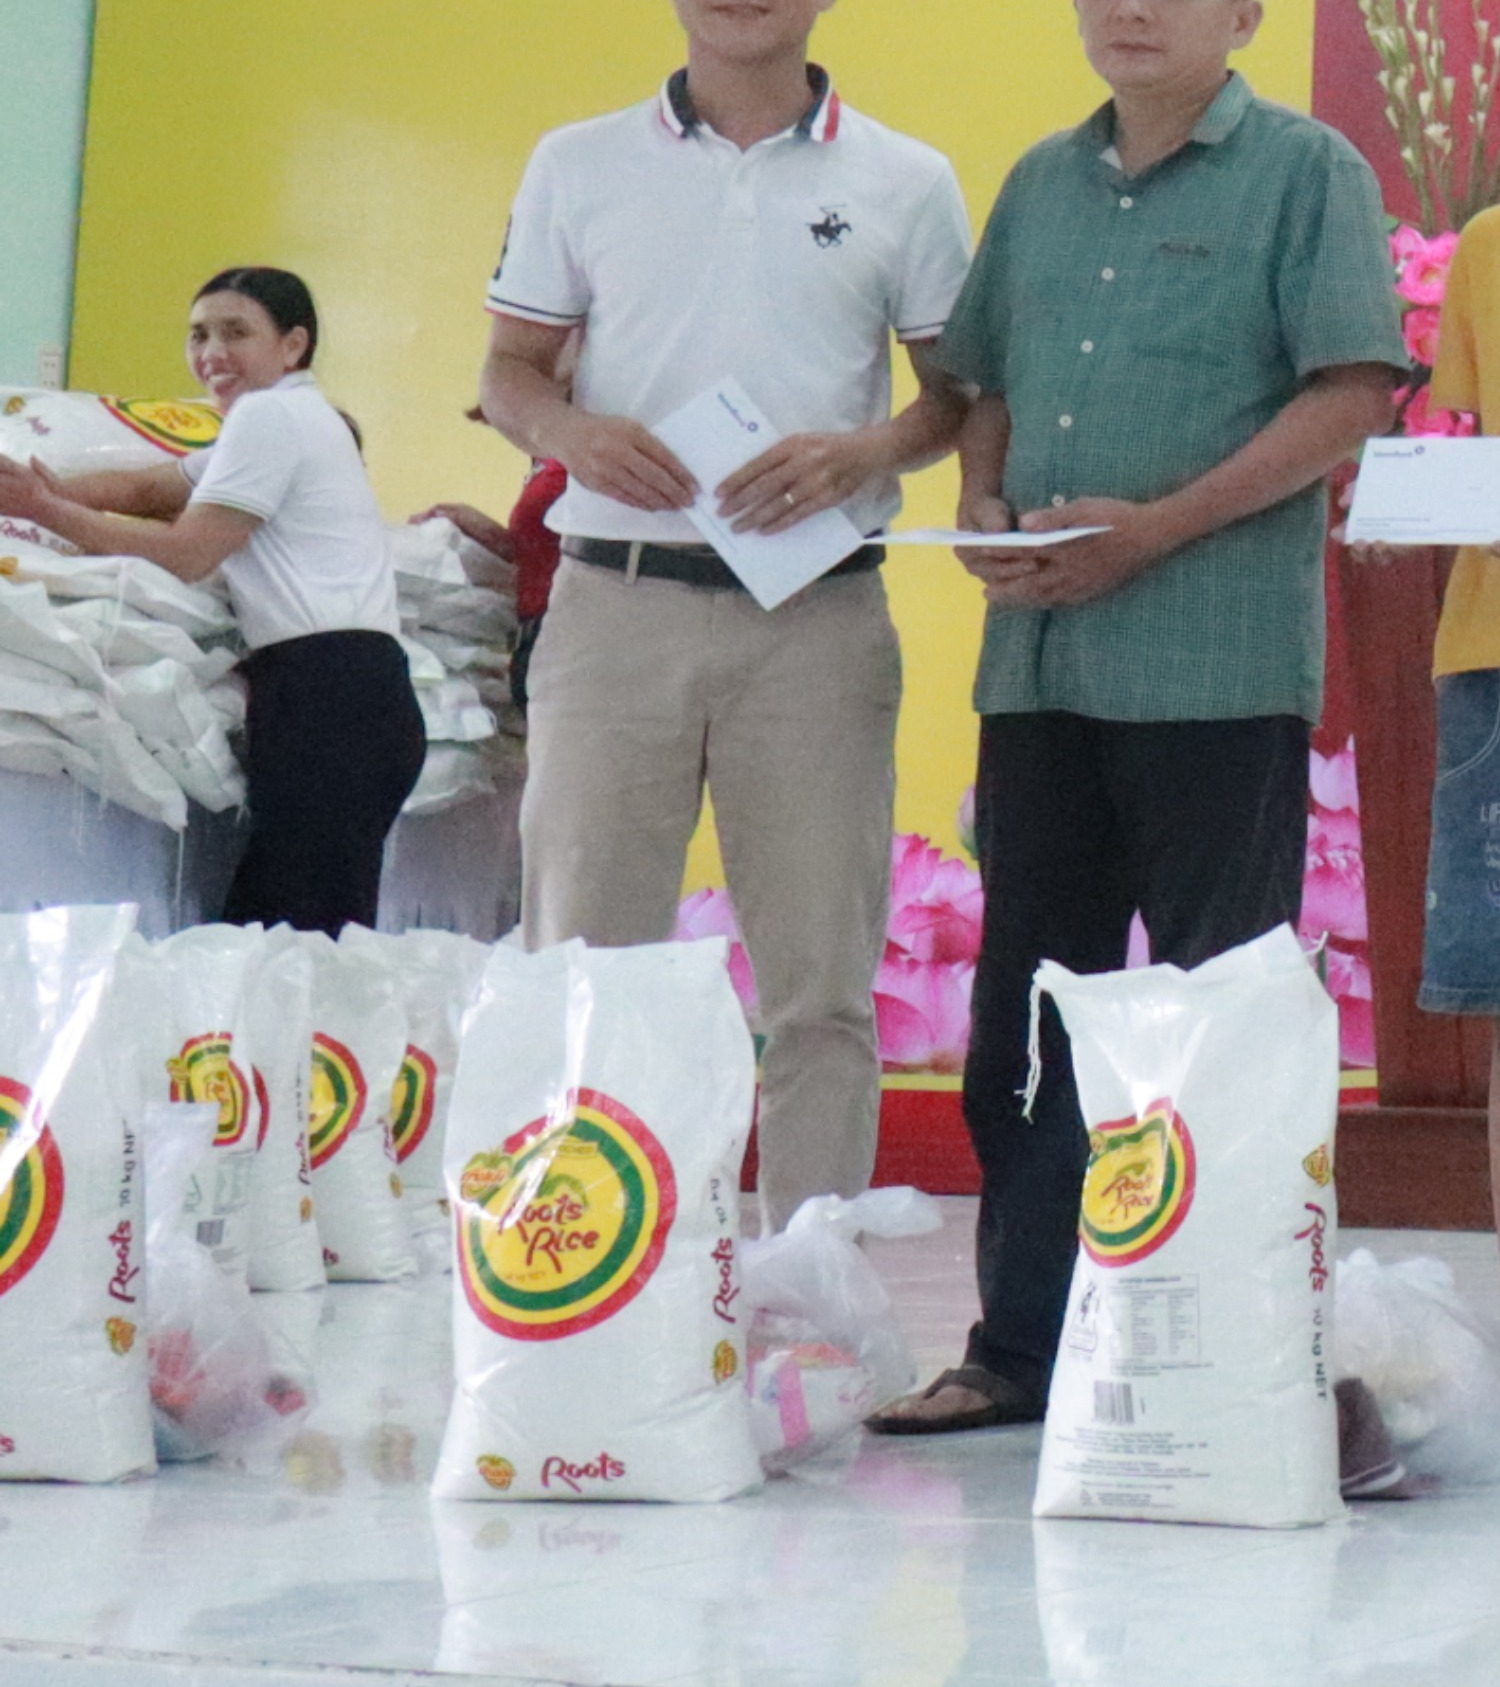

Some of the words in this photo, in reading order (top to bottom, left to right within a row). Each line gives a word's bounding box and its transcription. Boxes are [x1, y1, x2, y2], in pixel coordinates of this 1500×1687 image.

[108, 1219, 141, 1303] Roots
[526, 1226, 600, 1273] Rice
[711, 1237, 741, 1324] Roots
[1294, 1202, 1329, 1292] Roots
[541, 1451, 626, 1494] Roots
